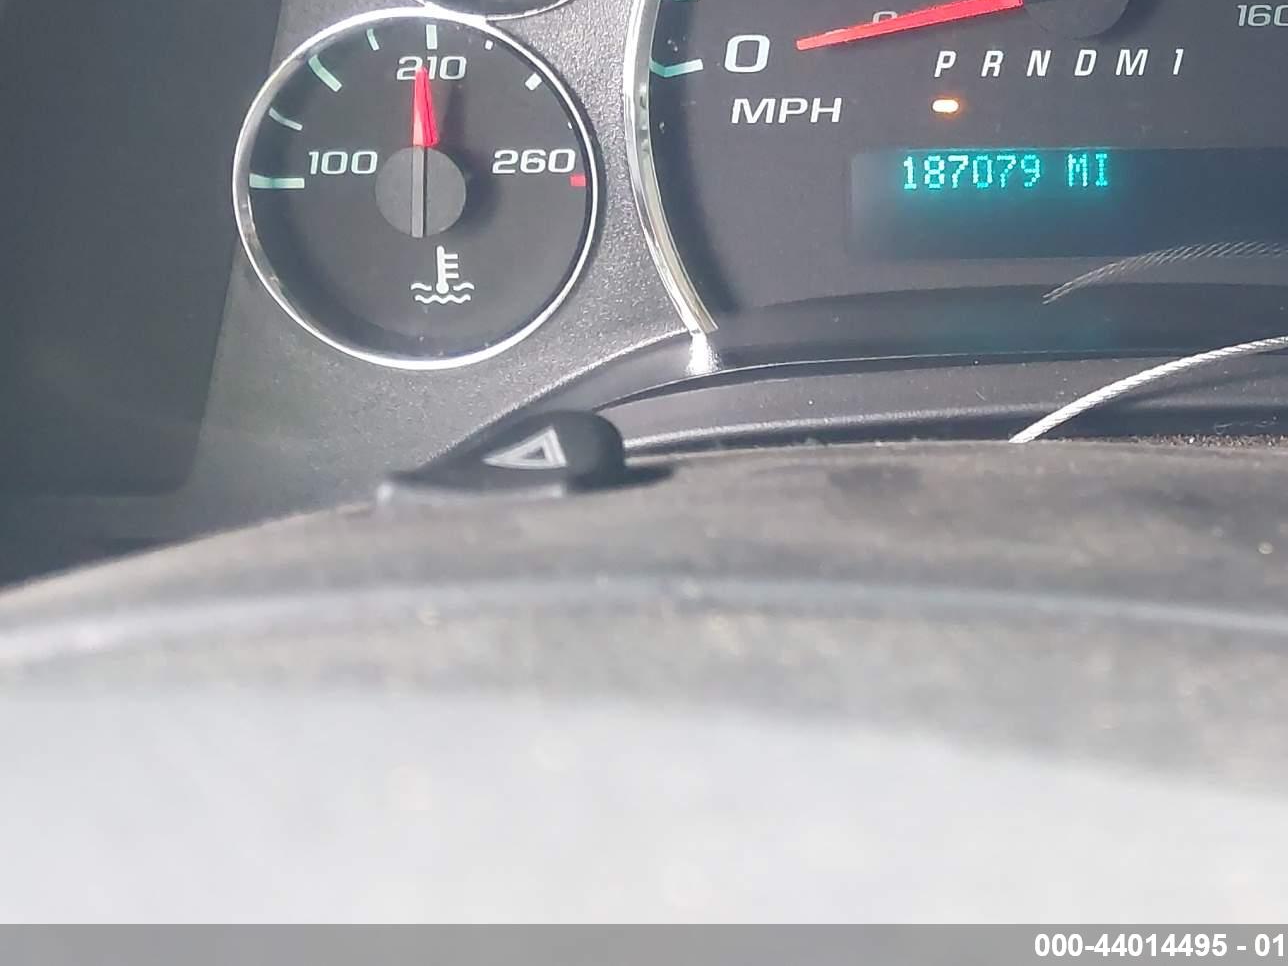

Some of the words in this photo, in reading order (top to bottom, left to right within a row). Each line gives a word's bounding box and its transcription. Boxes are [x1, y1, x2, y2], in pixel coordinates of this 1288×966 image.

[724, 34, 771, 73] 0
[934, 50, 957, 77] P
[981, 50, 1003, 77] R
[1026, 49, 1051, 77] N
[1074, 49, 1096, 77] D
[1116, 48, 1148, 75] M
[1173, 48, 1183, 75] 1
[396, 56, 466, 80] 210
[731, 97, 842, 123] MPH
[308, 150, 377, 175] 100
[492, 148, 575, 174] 260
[903, 155, 1041, 189] 187079
[1067, 153, 1109, 187] MI
